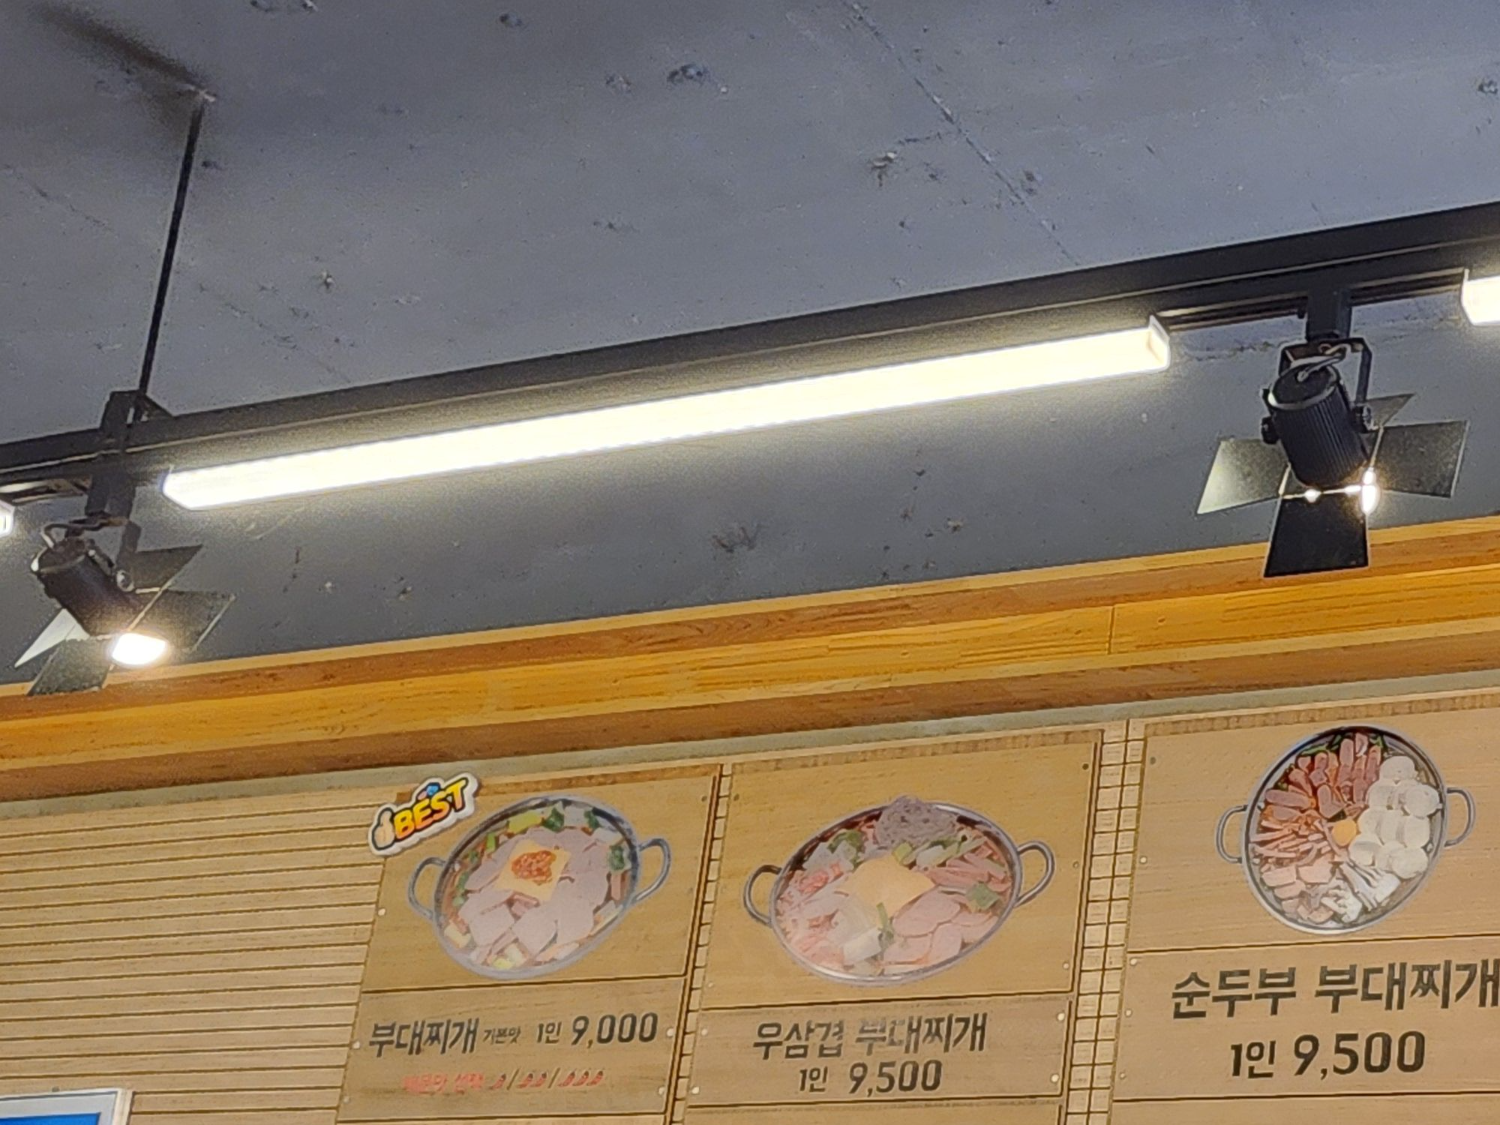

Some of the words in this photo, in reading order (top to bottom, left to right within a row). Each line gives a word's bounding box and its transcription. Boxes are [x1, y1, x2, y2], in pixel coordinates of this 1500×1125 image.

[392, 777, 469, 842] BEST
[1171, 967, 1297, 1020] 순두부
[368, 1018, 479, 1058] 부대찌개
[536, 1021, 562, 1044] 1인
[571, 1012, 659, 1049] 9,000
[752, 1020, 844, 1061] 우삼겹
[855, 1012, 988, 1057] 부대찌개
[1230, 1040, 1276, 1079] 1인
[1293, 1030, 1426, 1080] 9,500
[799, 1066, 828, 1092] 1인
[848, 1059, 943, 1097] 9,500
